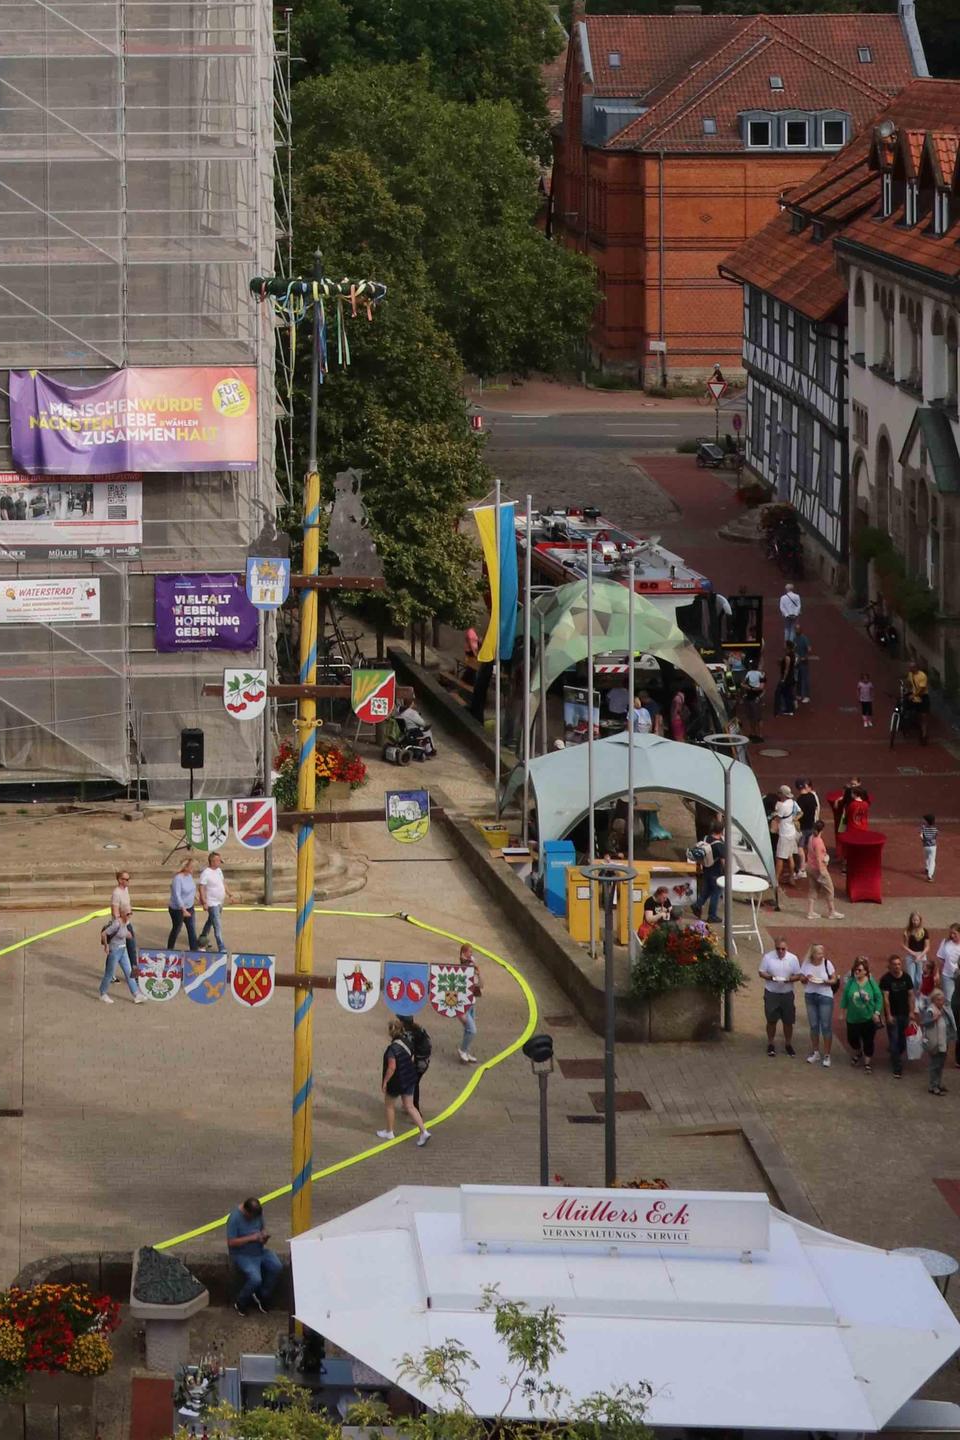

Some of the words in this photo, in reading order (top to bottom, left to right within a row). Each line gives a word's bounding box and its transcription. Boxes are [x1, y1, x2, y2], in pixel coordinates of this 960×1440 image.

[217, 382, 240, 398] FÜR
[49, 395, 203, 417] MENSCHENWÜRDE
[220, 391, 246, 409] ALLE
[29, 410, 157, 433] NÄCHSTENLIEBE
[81, 426, 218, 446] ZUSAMMENHALT
[19, 586, 77, 597] WATERSTRADT
[174, 594, 232, 605] VIELFALT
[175, 616, 240, 626] HOFFNUNG
[175, 627, 220, 637] GEBEN.
[542, 1198, 639, 1223] Müllers
[646, 1200, 690, 1225] Eck
[542, 1228, 637, 1240] VERANSTALTUNGS
[647, 1232, 690, 1241] SERVICE
